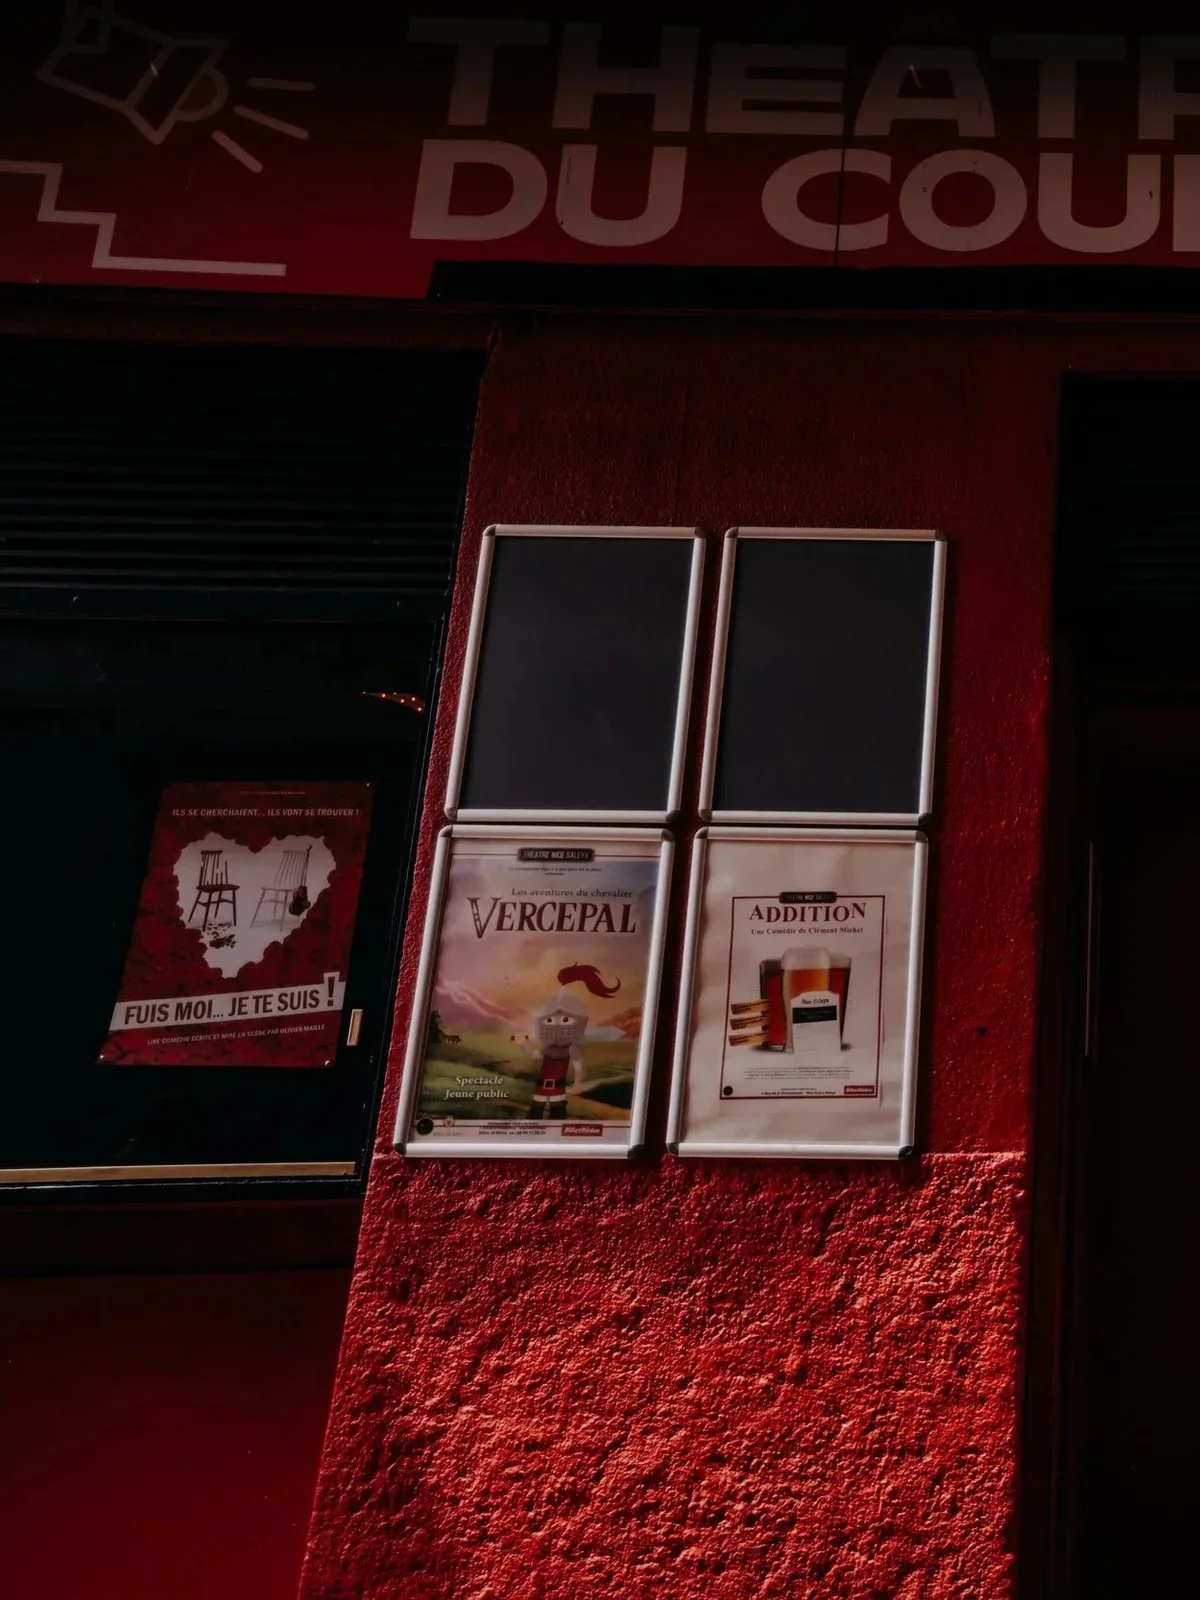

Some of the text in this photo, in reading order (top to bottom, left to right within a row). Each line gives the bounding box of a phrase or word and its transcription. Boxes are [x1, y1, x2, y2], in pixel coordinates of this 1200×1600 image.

[408, 138, 689, 247] DU
[172, 808, 186, 817] ILS
[187, 808, 199, 817] SE
[267, 808, 281, 817] ILS
[282, 808, 303, 817] VONT
[304, 808, 316, 817] SE
[317, 808, 354, 817] TROUVER
[511, 888, 633, 898] Les aventures du chevalier
[467, 898, 637, 938] VERCEPAL
[749, 903, 867, 923] ADDITION
[124, 1003, 170, 1025] FUIS
[174, 999, 224, 1021] MOI...
[228, 996, 249, 1017] JE
[252, 993, 273, 1014] TE
[277, 989, 320, 1012] SUIS
[455, 1075, 504, 1087] Spectacle
[443, 1089, 510, 1100] Jeune public
